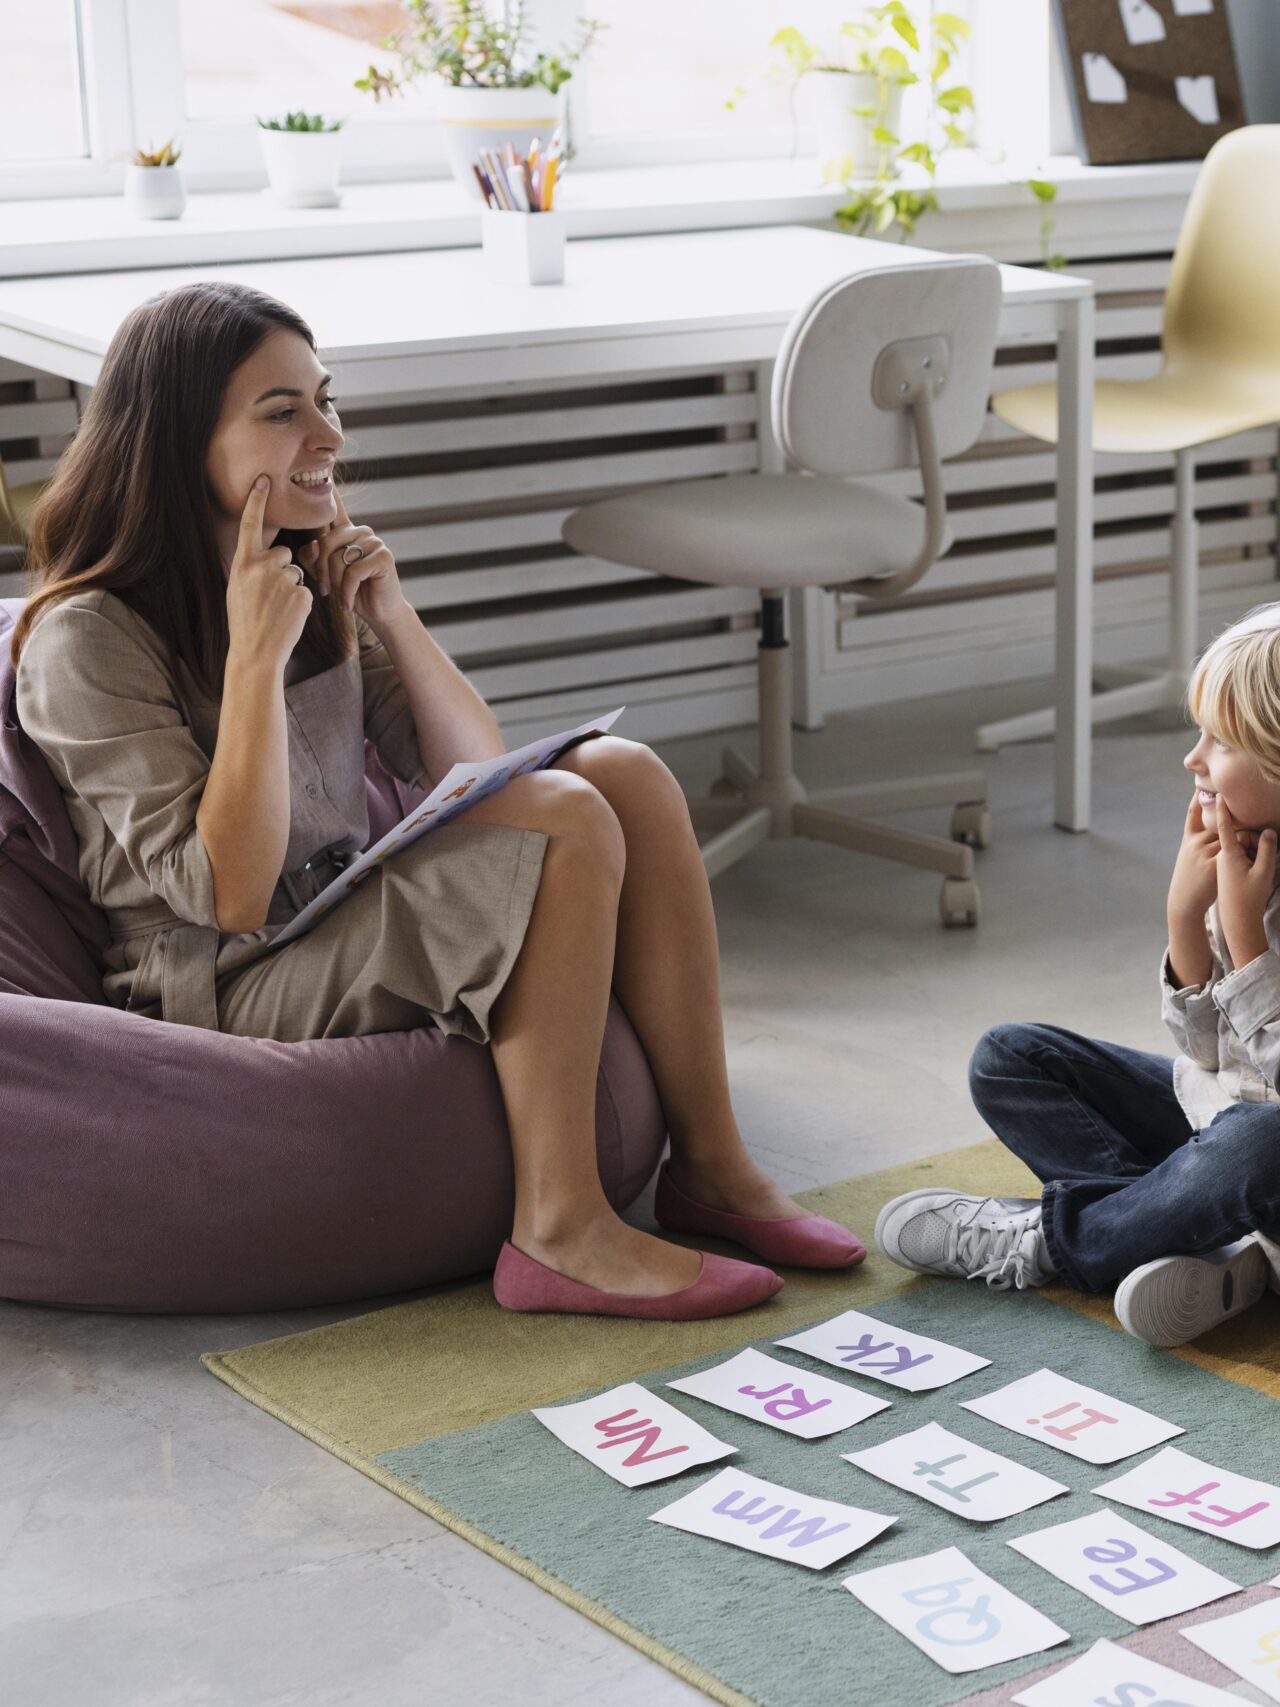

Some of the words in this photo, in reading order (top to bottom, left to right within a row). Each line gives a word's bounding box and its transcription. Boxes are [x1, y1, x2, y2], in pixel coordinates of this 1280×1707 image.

[836, 1334, 934, 1375] Kk
[737, 1382, 833, 1420] Rr
[1026, 1401, 1119, 1442] Ii
[594, 1408, 690, 1467] Nn
[912, 1453, 1000, 1503] Tt
[711, 1490, 852, 1548] Mm
[1147, 1482, 1270, 1528] Ff
[1082, 1538, 1178, 1596] Ee
[901, 1576, 1001, 1646] Qq
[1093, 1682, 1200, 1707] s
